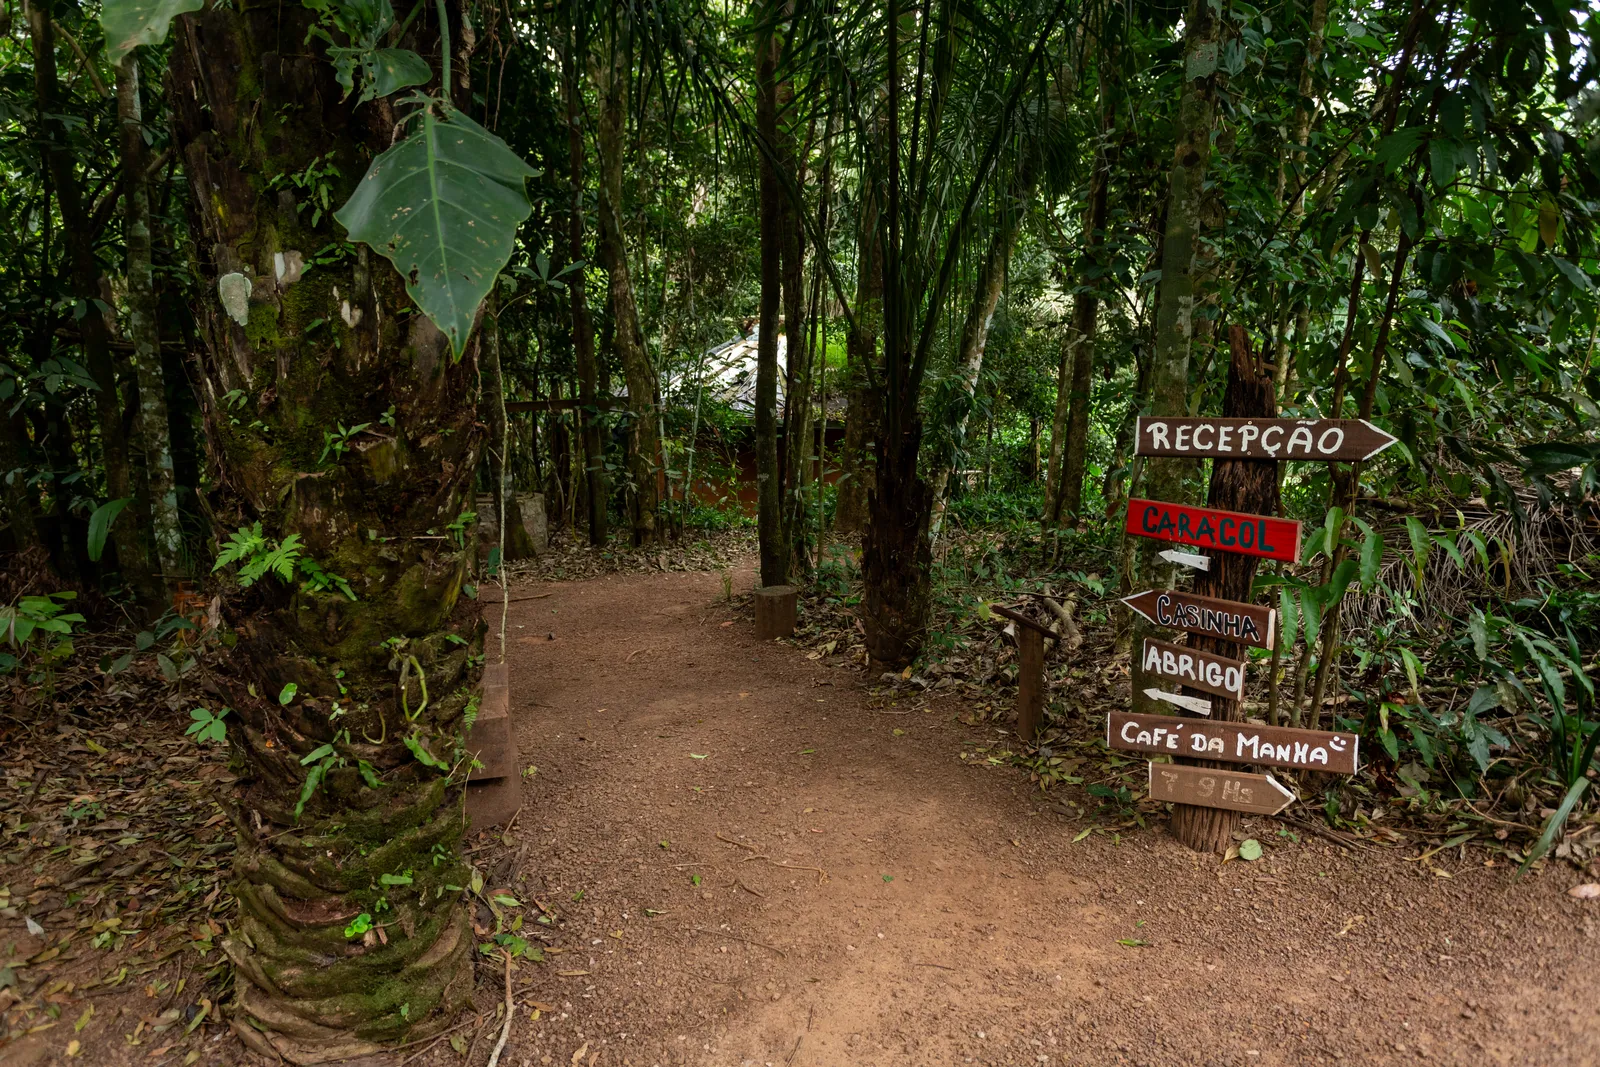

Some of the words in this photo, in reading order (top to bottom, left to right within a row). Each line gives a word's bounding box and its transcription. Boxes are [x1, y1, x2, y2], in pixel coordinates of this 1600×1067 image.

[1146, 420, 1345, 457] RECEPÇÃO
[1142, 505, 1275, 552] CARACOL
[1156, 595, 1261, 643] CASINHA
[1145, 646, 1241, 692] ABRIGO
[1190, 733, 1225, 753] DA
[1198, 776, 1216, 798] 9
